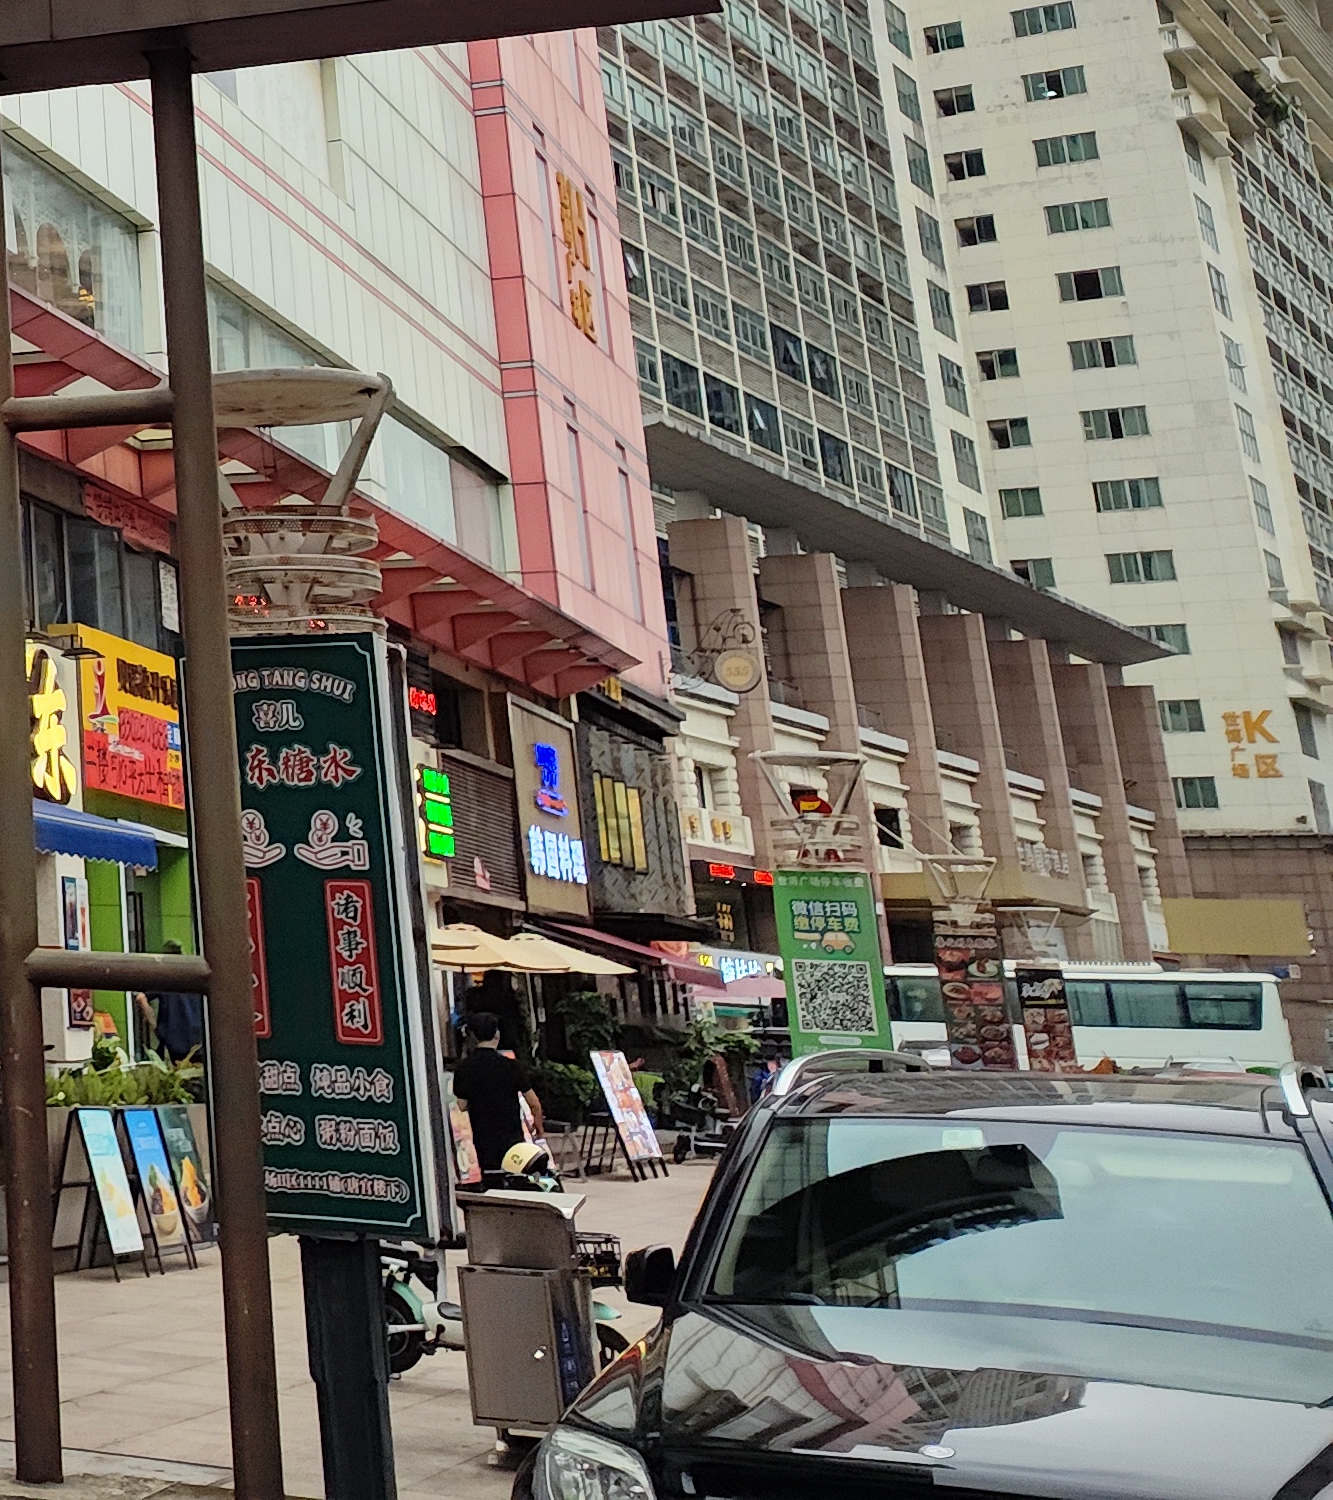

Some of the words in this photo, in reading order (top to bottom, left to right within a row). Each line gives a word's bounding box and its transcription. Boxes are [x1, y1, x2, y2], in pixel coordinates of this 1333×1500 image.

[263, 668, 308, 690] TANG
[310, 672, 356, 703] SHUI
[791, 899, 858, 918] 微信扫码
[331, 890, 373, 1034] 诸事顺利
[261, 1111, 305, 1145] 点心
